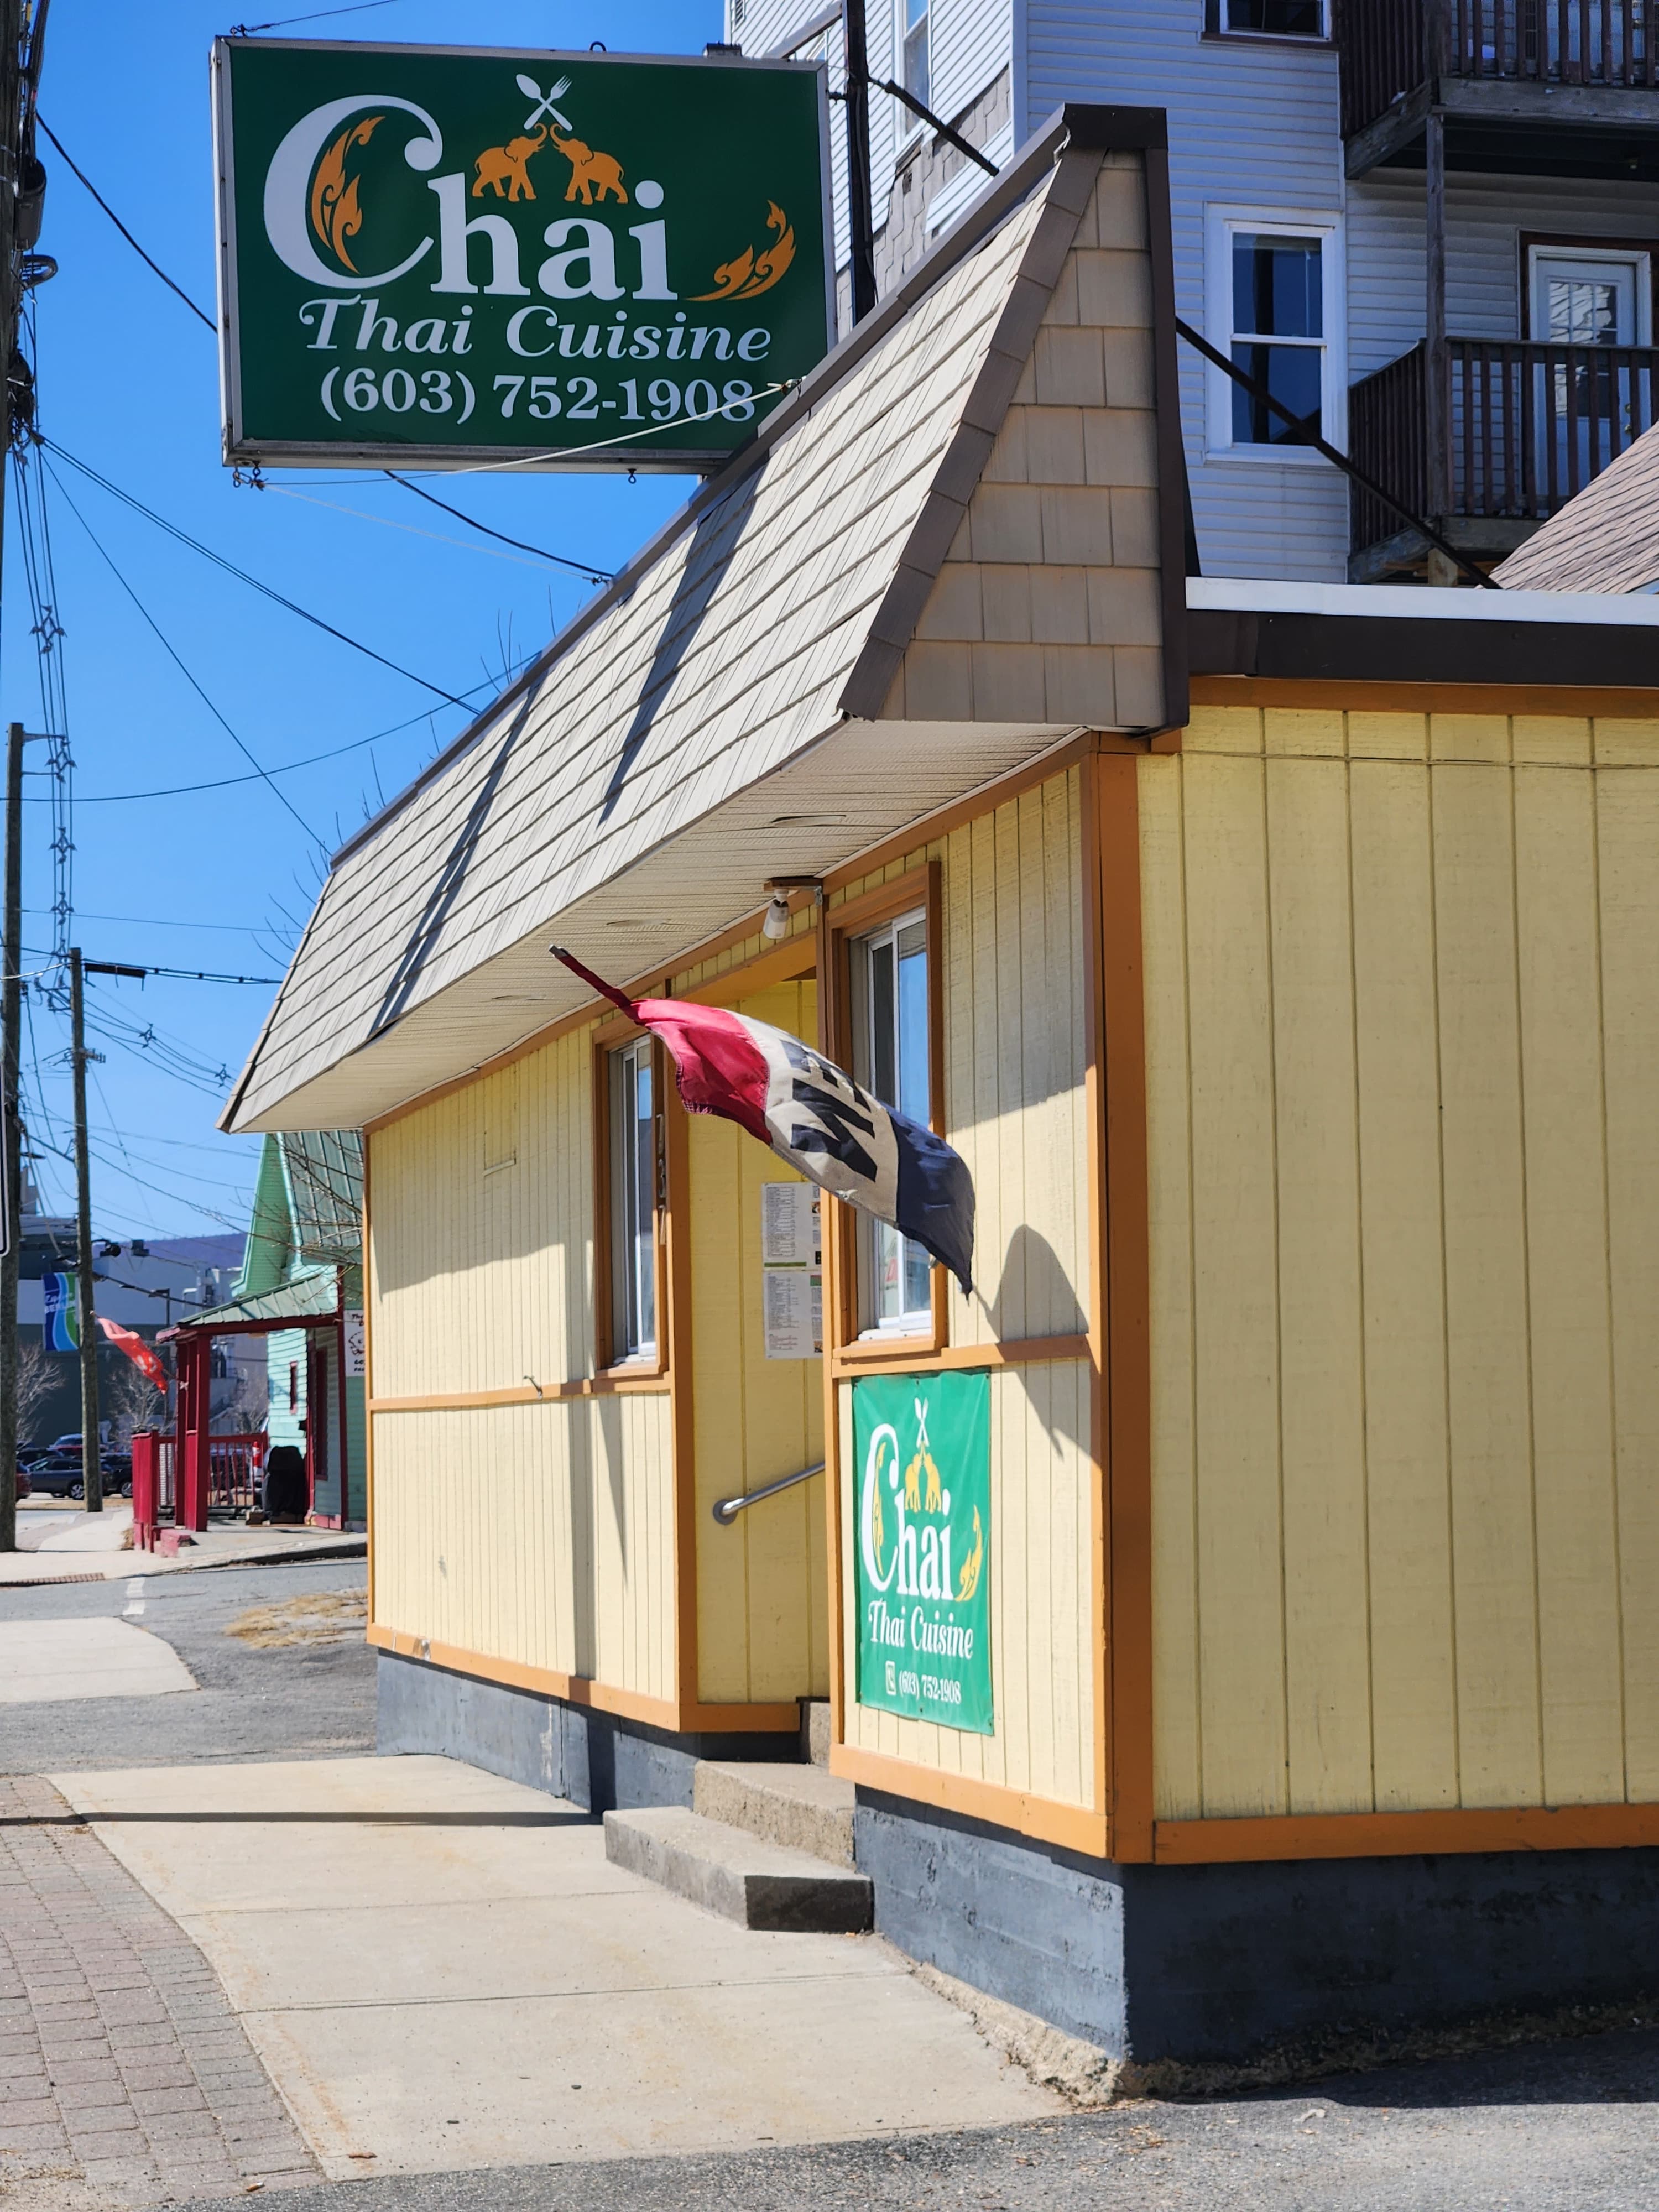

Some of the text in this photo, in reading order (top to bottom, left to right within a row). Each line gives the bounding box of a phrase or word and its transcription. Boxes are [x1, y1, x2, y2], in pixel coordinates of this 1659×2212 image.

[263, 93, 679, 301] Chai
[299, 294, 771, 362] Thai Cuisine
[320, 365, 757, 426] (603) 752-1908
[860, 1423, 956, 1601] Chai
[868, 1598, 974, 1660] Thai Cuisine
[899, 1670, 962, 1705] (603) 752-1908
